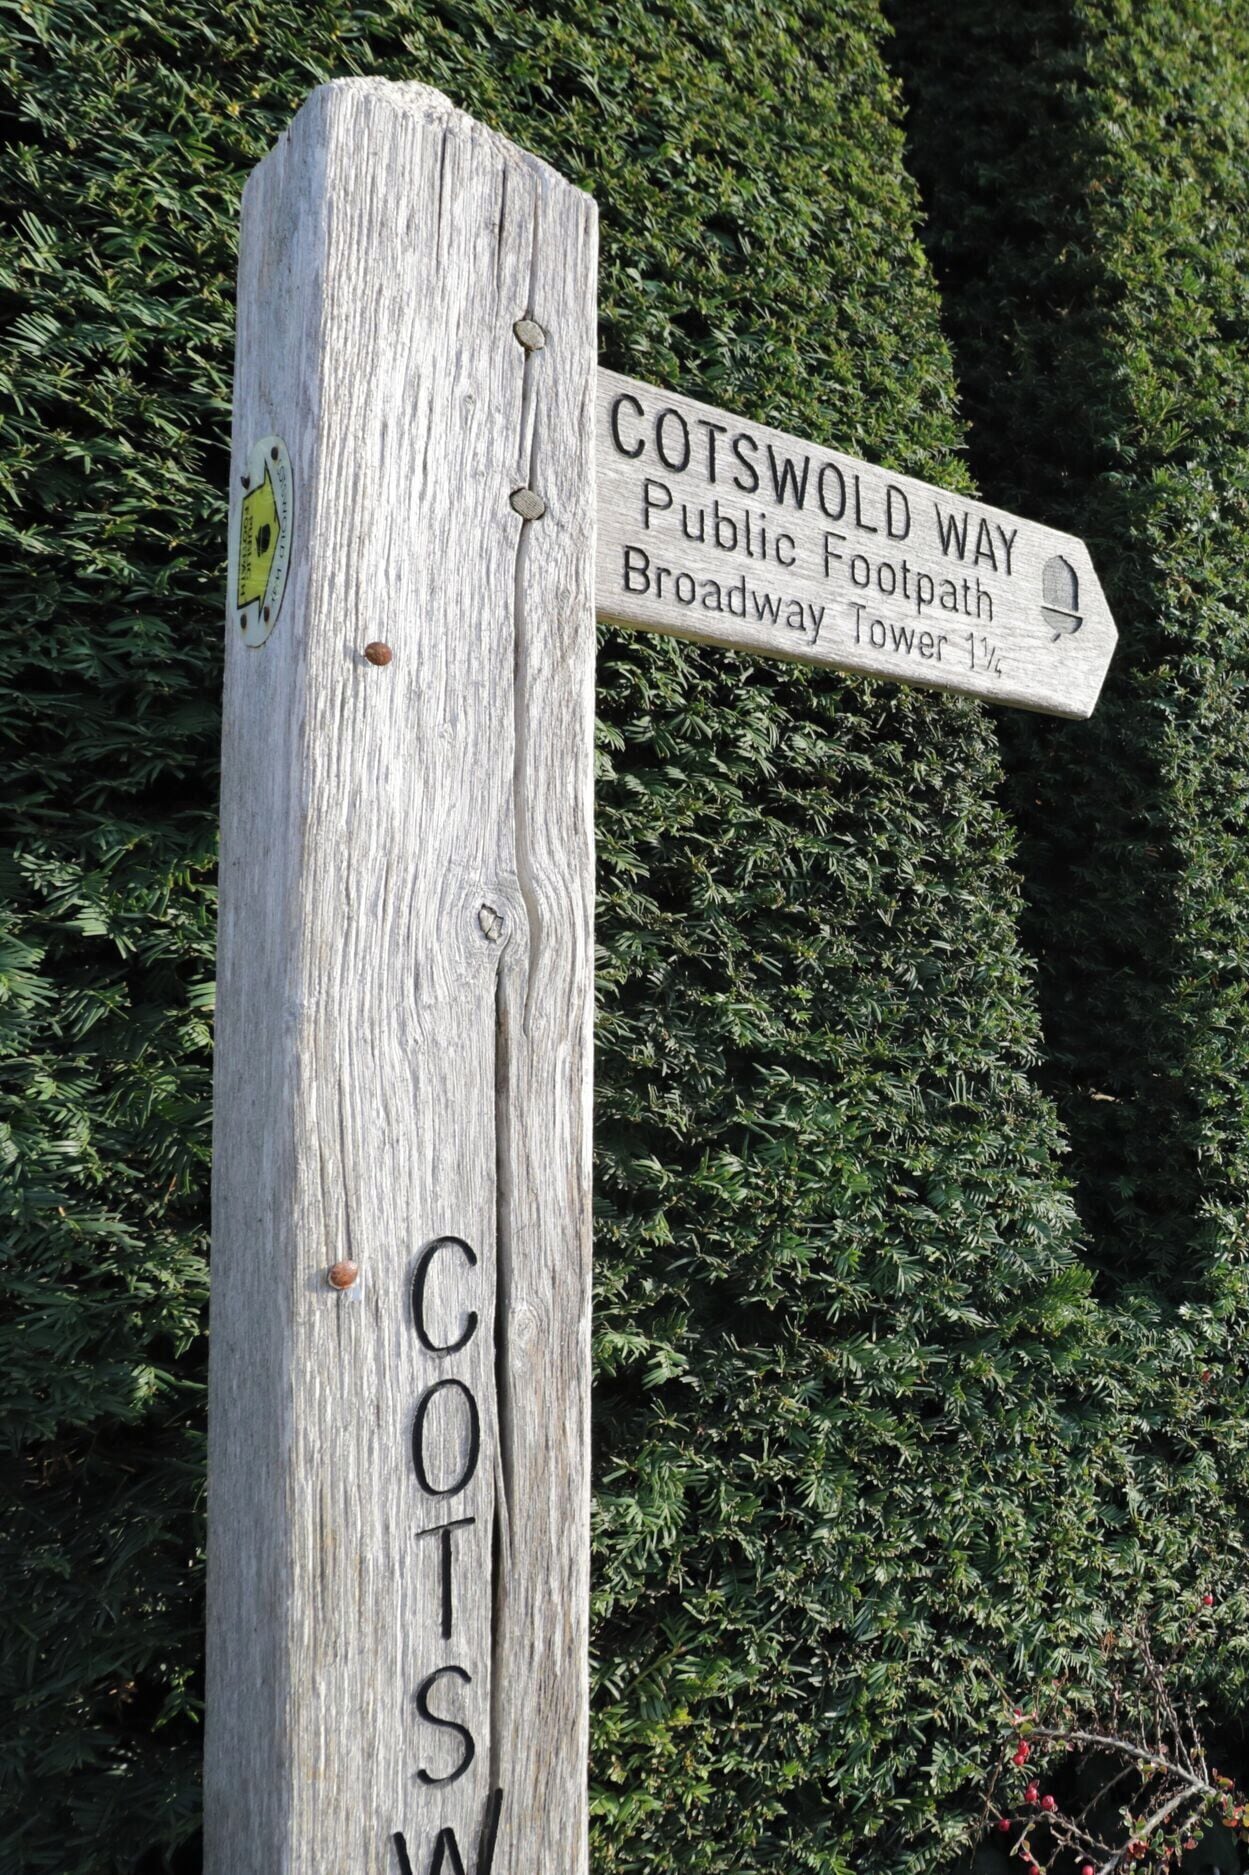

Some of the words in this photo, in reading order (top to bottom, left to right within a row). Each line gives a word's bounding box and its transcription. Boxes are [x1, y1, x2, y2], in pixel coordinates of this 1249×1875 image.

[610, 393, 912, 541] COTSWOLD
[934, 502, 1018, 577] WAY
[643, 477, 796, 567] Public
[823, 530, 994, 621] Footpath
[623, 545, 825, 644] Broadway
[850, 600, 948, 662] Tower
